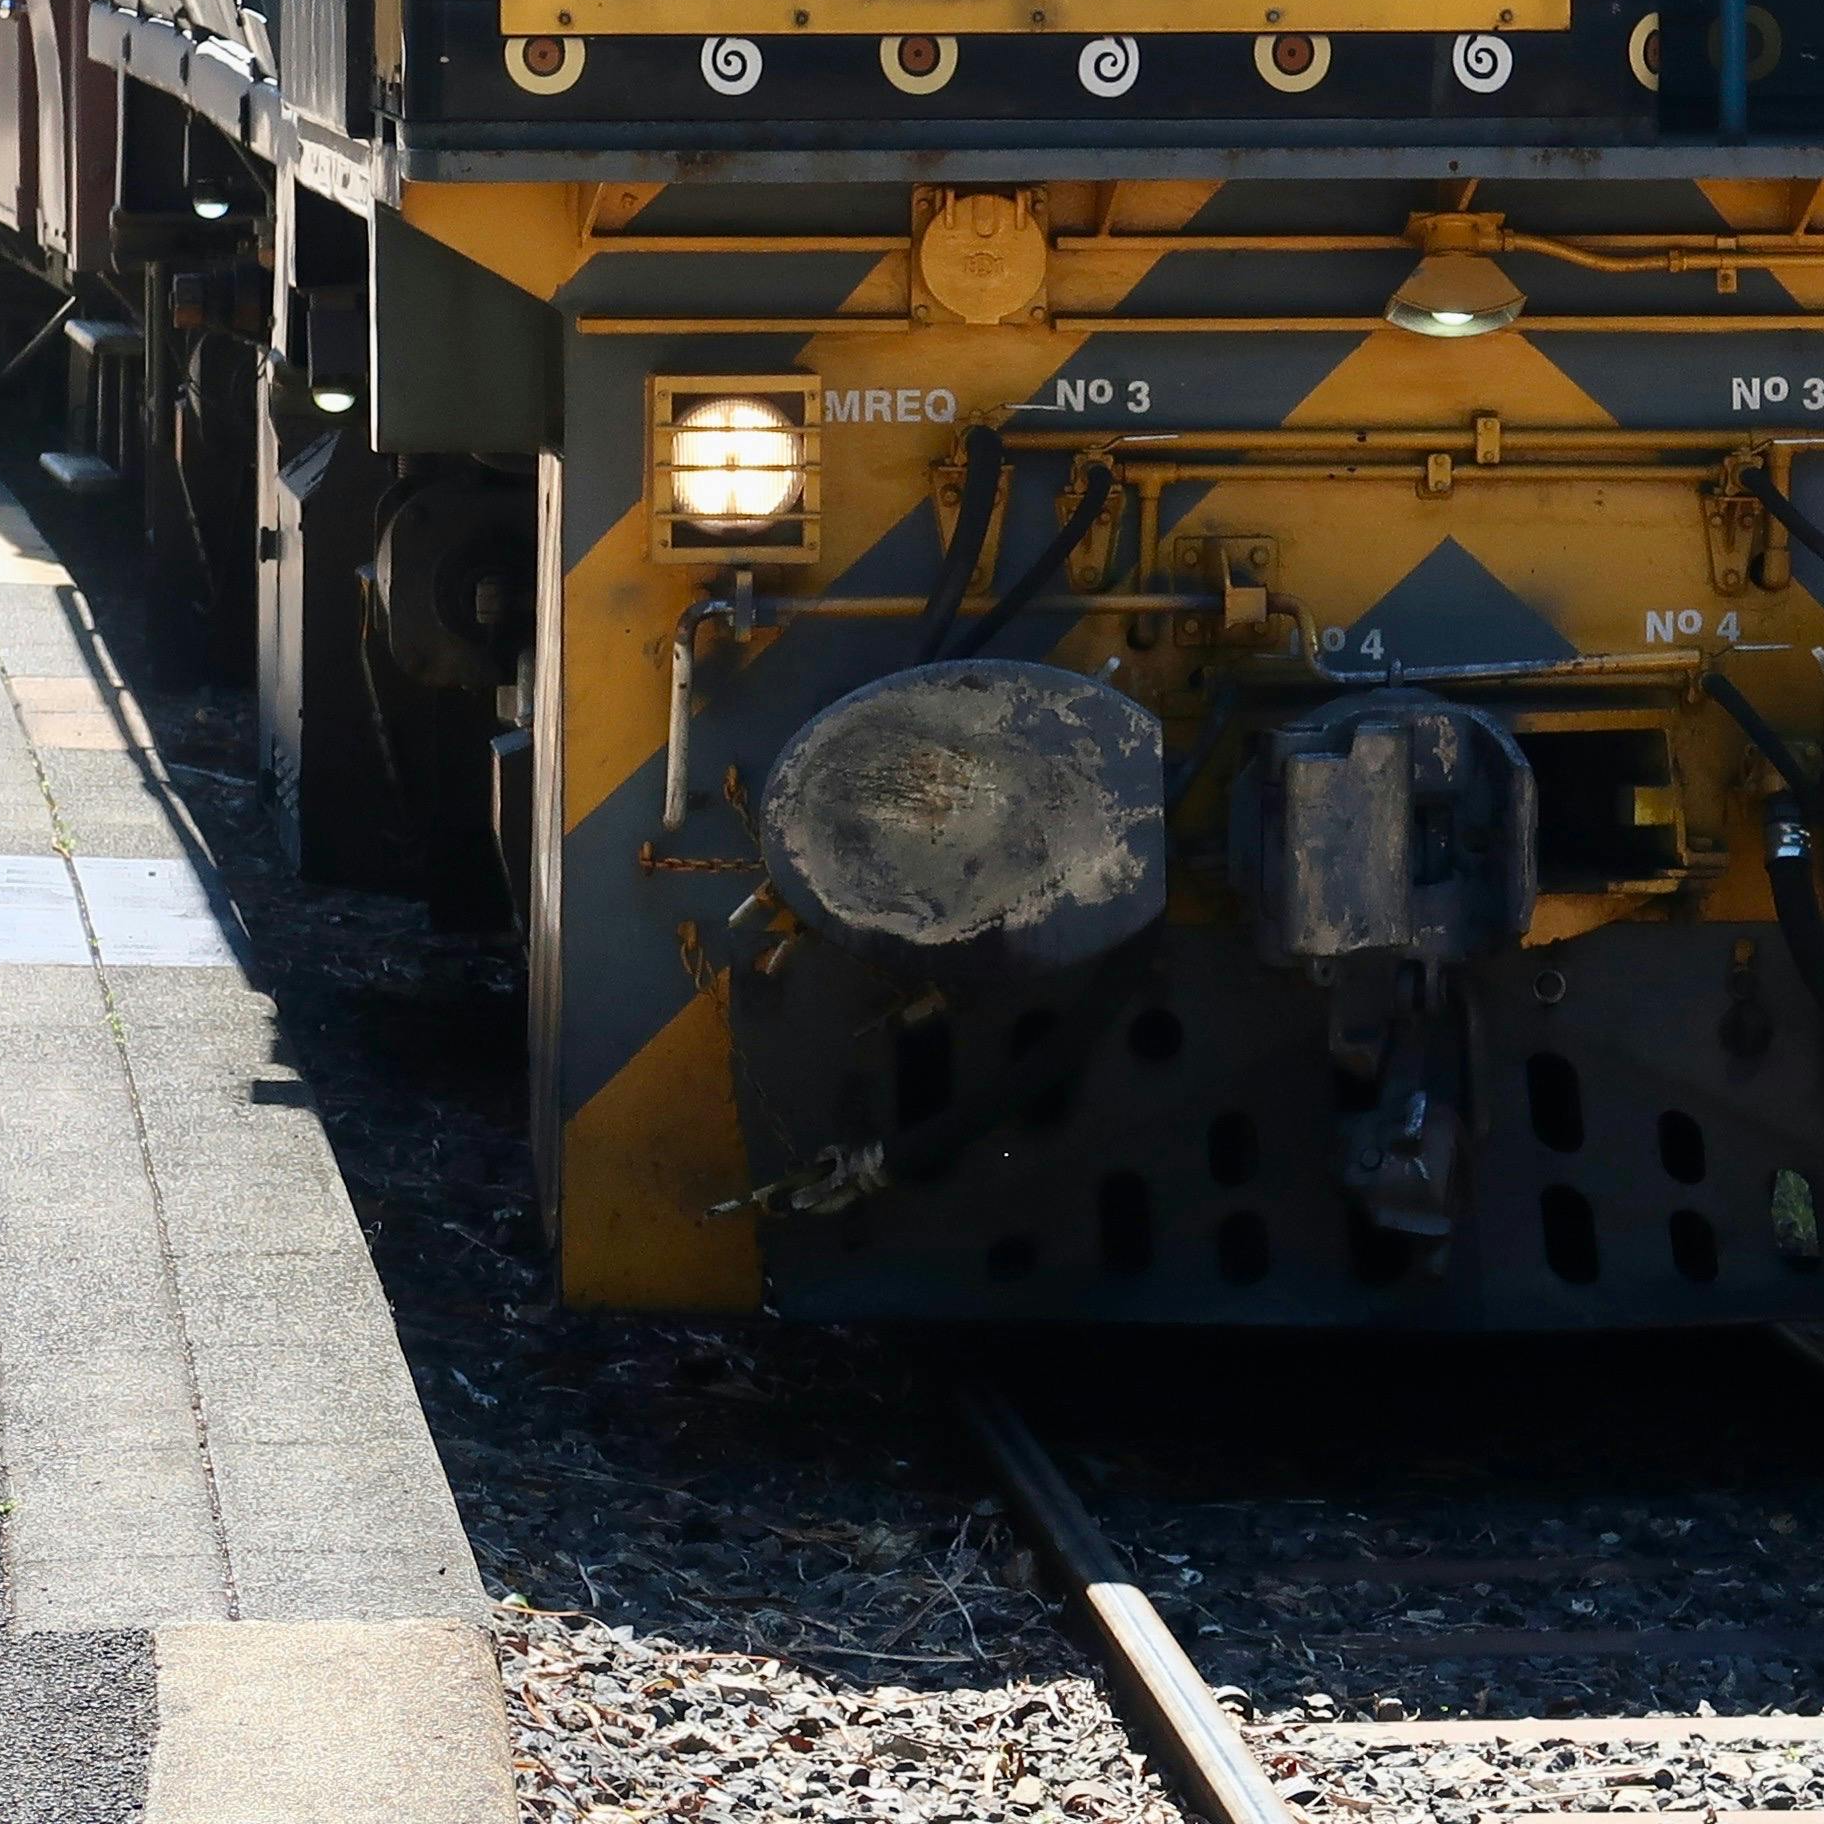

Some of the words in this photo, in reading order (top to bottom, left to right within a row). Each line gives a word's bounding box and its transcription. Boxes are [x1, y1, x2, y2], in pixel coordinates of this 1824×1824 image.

[824, 388, 958, 423] MREQ
[1127, 380, 1151, 413] 3
[1717, 611, 1741, 642] 4
[1360, 627, 1385, 660] 4
